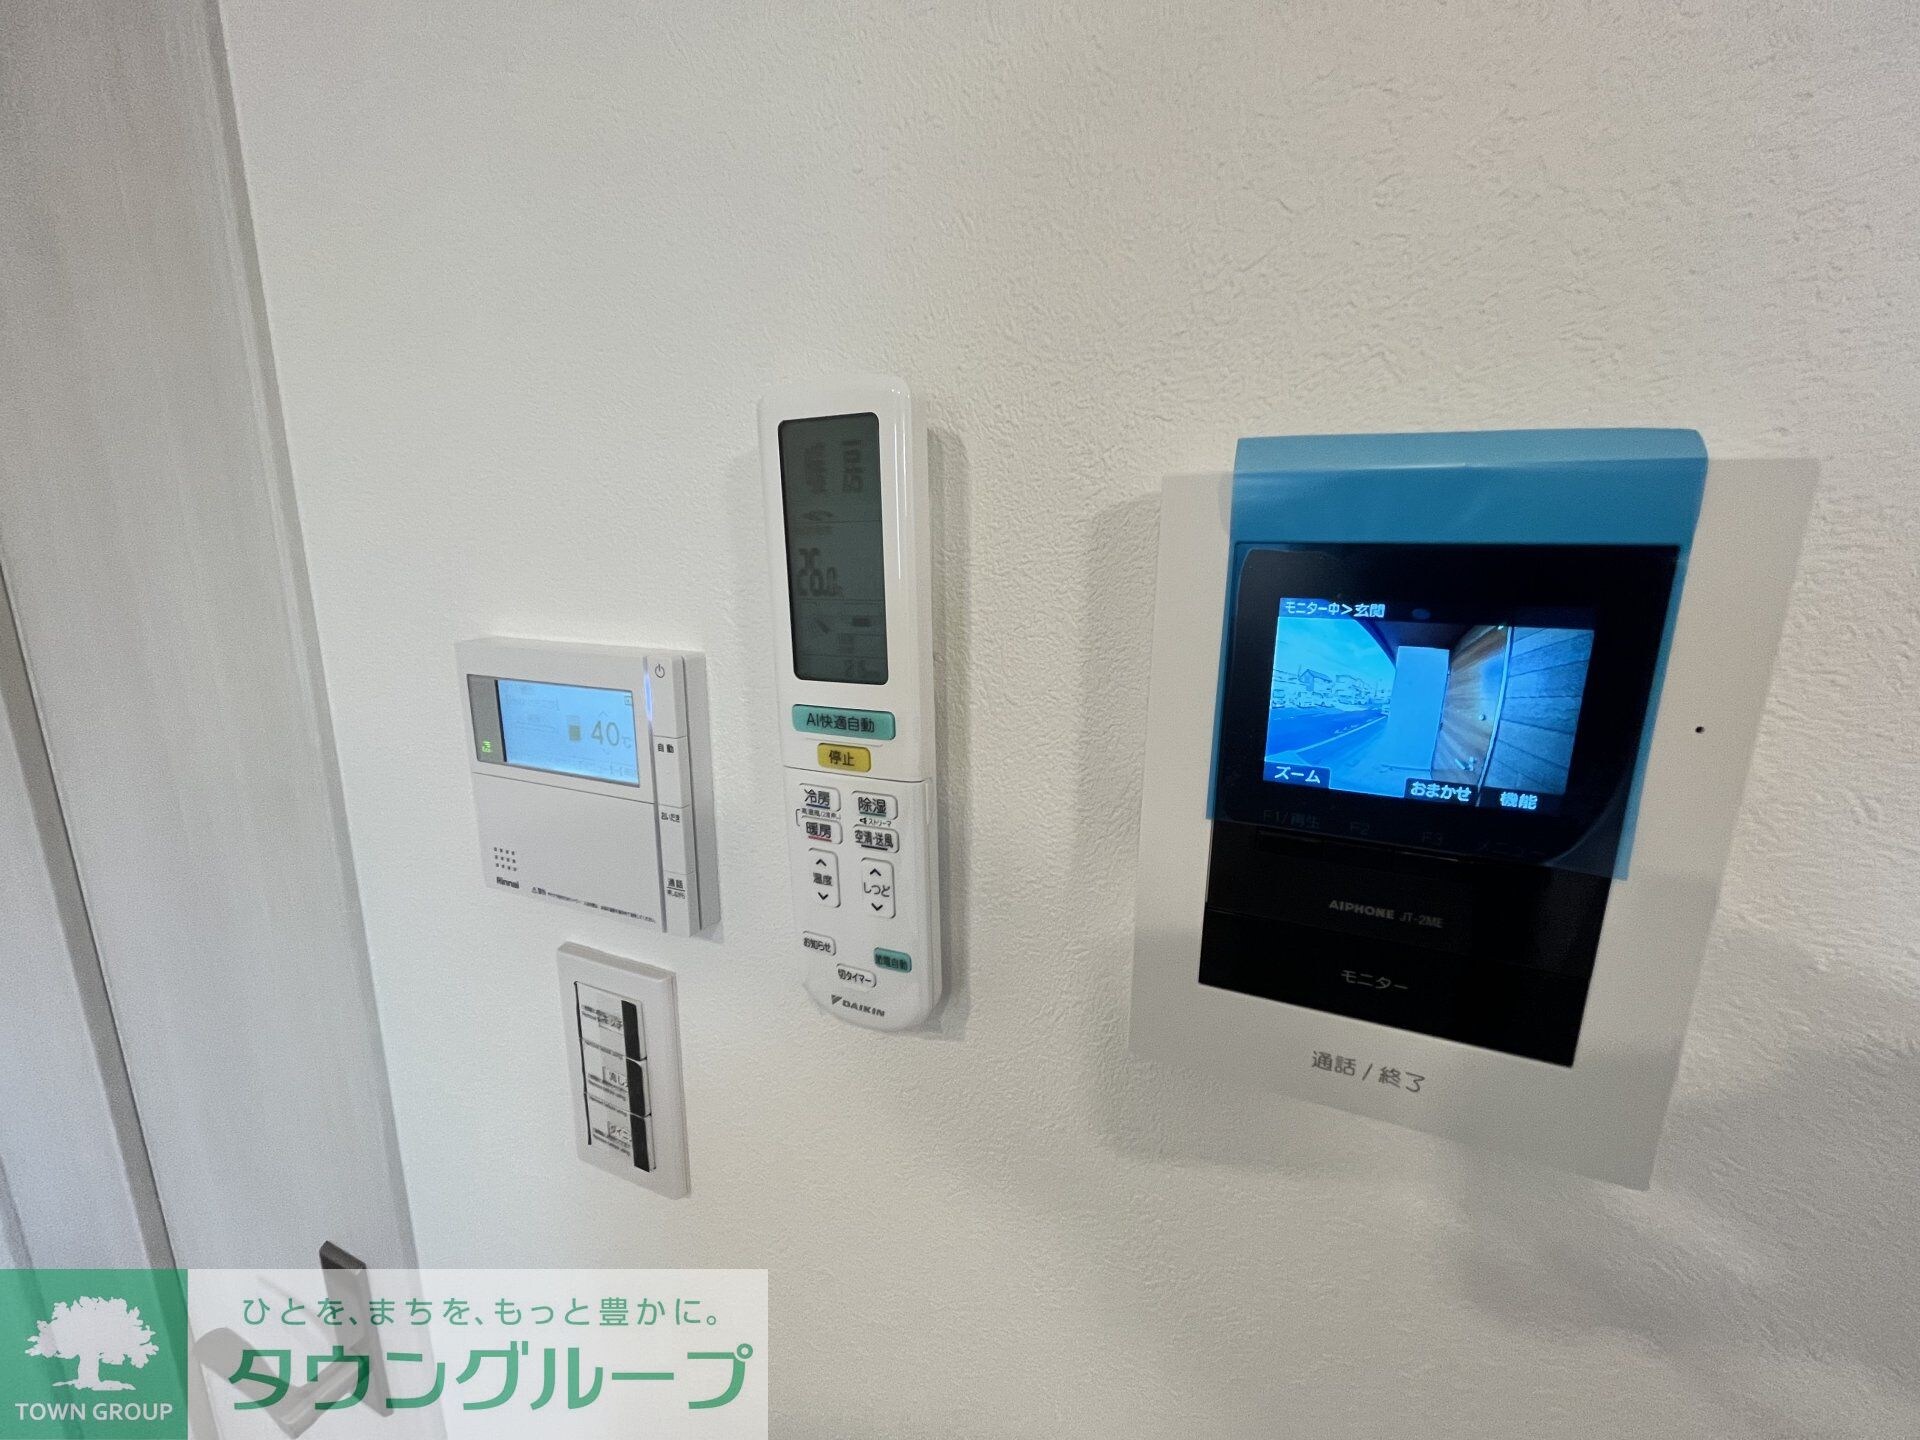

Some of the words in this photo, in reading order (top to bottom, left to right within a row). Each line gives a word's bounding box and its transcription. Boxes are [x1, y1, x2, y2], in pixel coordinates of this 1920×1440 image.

[806, 712, 875, 733] AI快適自動
[828, 749, 855, 767] 停止
[1273, 765, 1321, 784] ズーム
[803, 788, 831, 807] 冷房
[1409, 781, 1472, 802] おまかせ
[1499, 791, 1538, 810] 機能
[857, 796, 888, 815] 除湿
[805, 821, 832, 839] 暖房
[496, 876, 520, 890] Rinnai
[812, 872, 834, 887] 温度
[1329, 899, 1395, 920] AIPHONE
[1399, 912, 1444, 929] JT-2ME
[803, 936, 831, 954] お知らせ
[837, 967, 872, 985] 切タイマー
[1340, 969, 1409, 990] モニター
[842, 999, 886, 1018] DAIKIN
